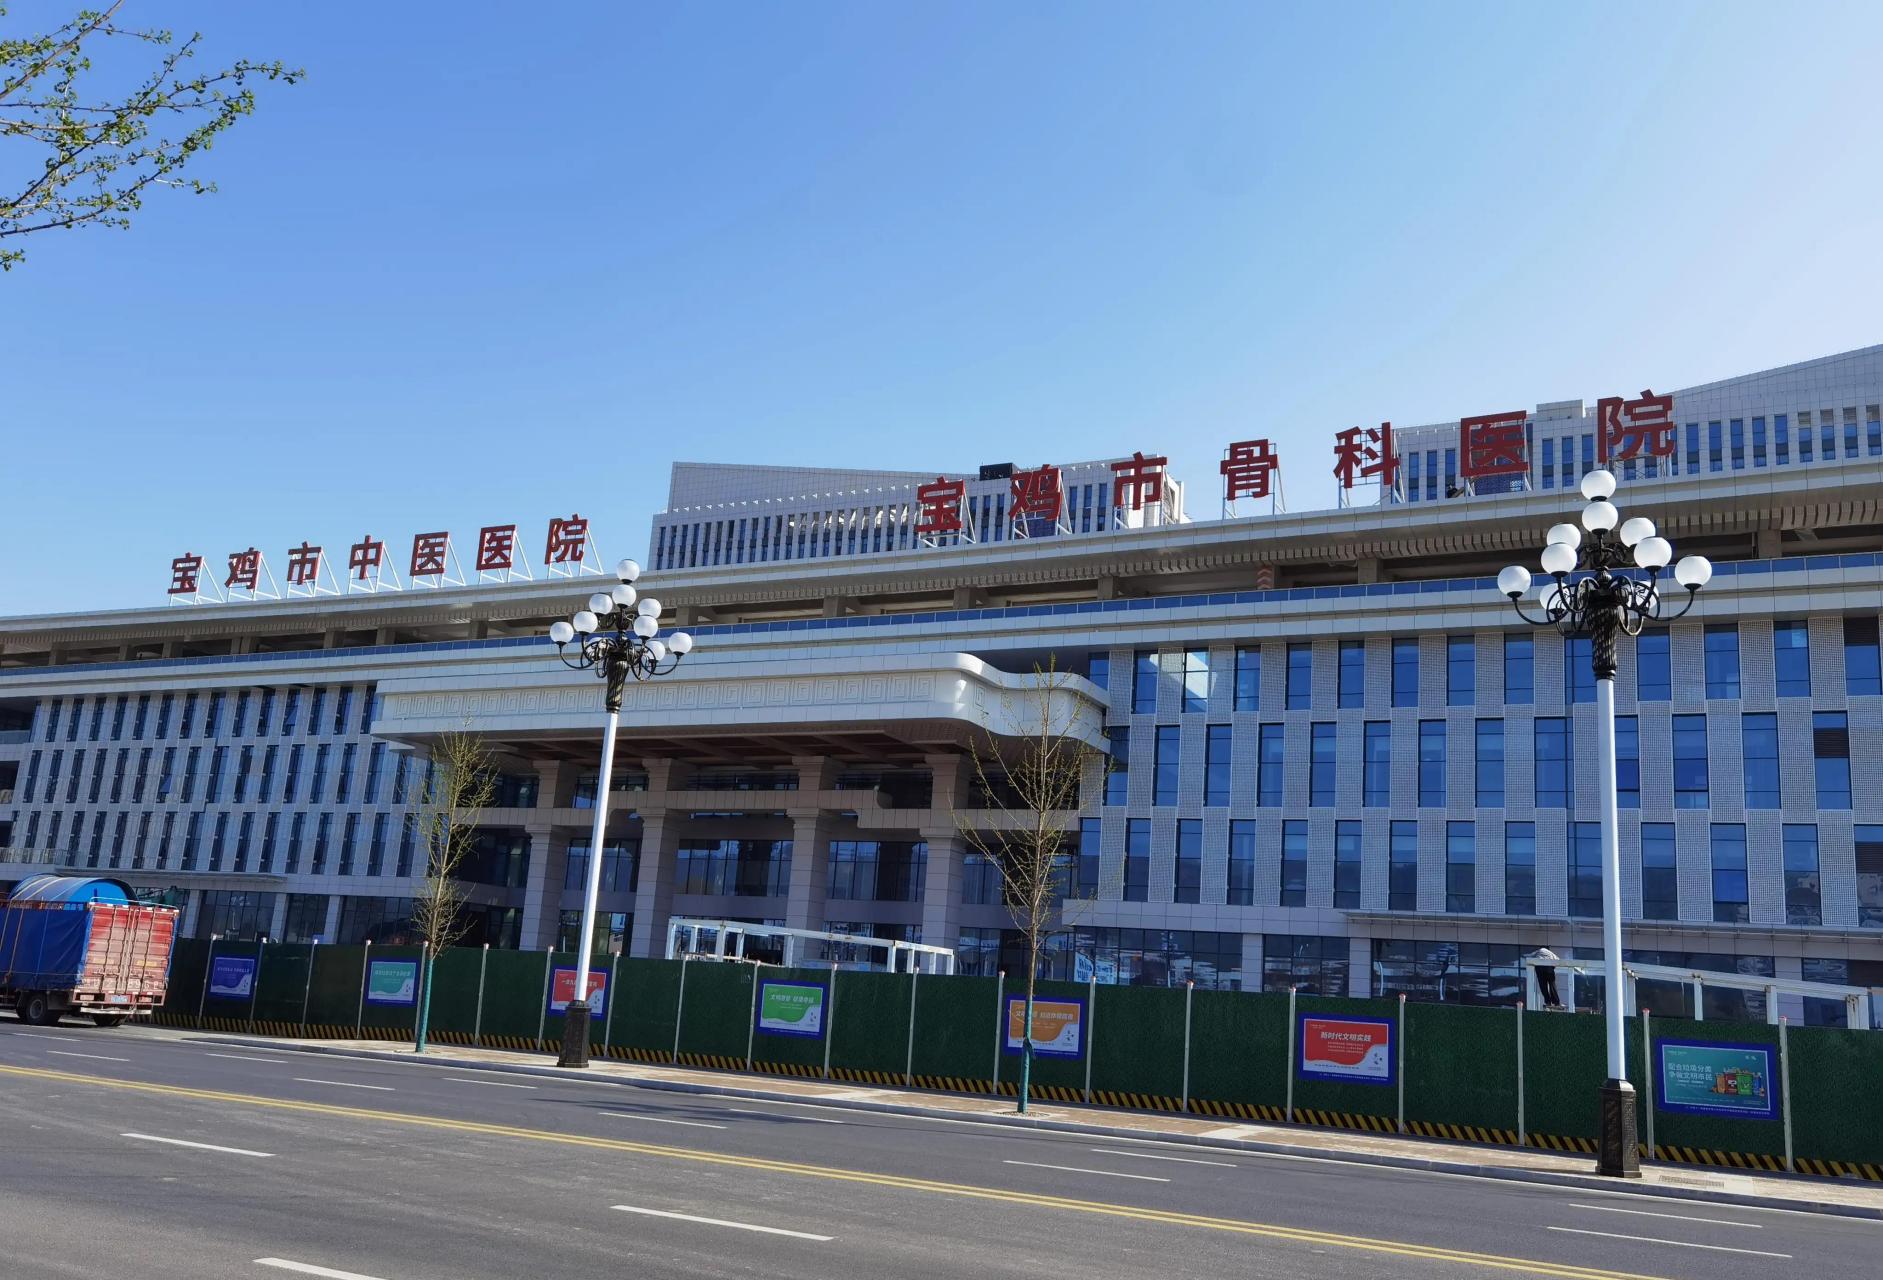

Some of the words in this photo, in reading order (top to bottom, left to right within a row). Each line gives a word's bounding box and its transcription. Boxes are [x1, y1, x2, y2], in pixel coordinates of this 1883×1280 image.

[914, 388, 1675, 535] 宝鸡市骨科医院
[167, 513, 588, 595] 宝鸡市中医医院
[1320, 1031, 1372, 1042] 新时代文明实践
[1668, 1062, 1712, 1073] 配合垃圾分类
